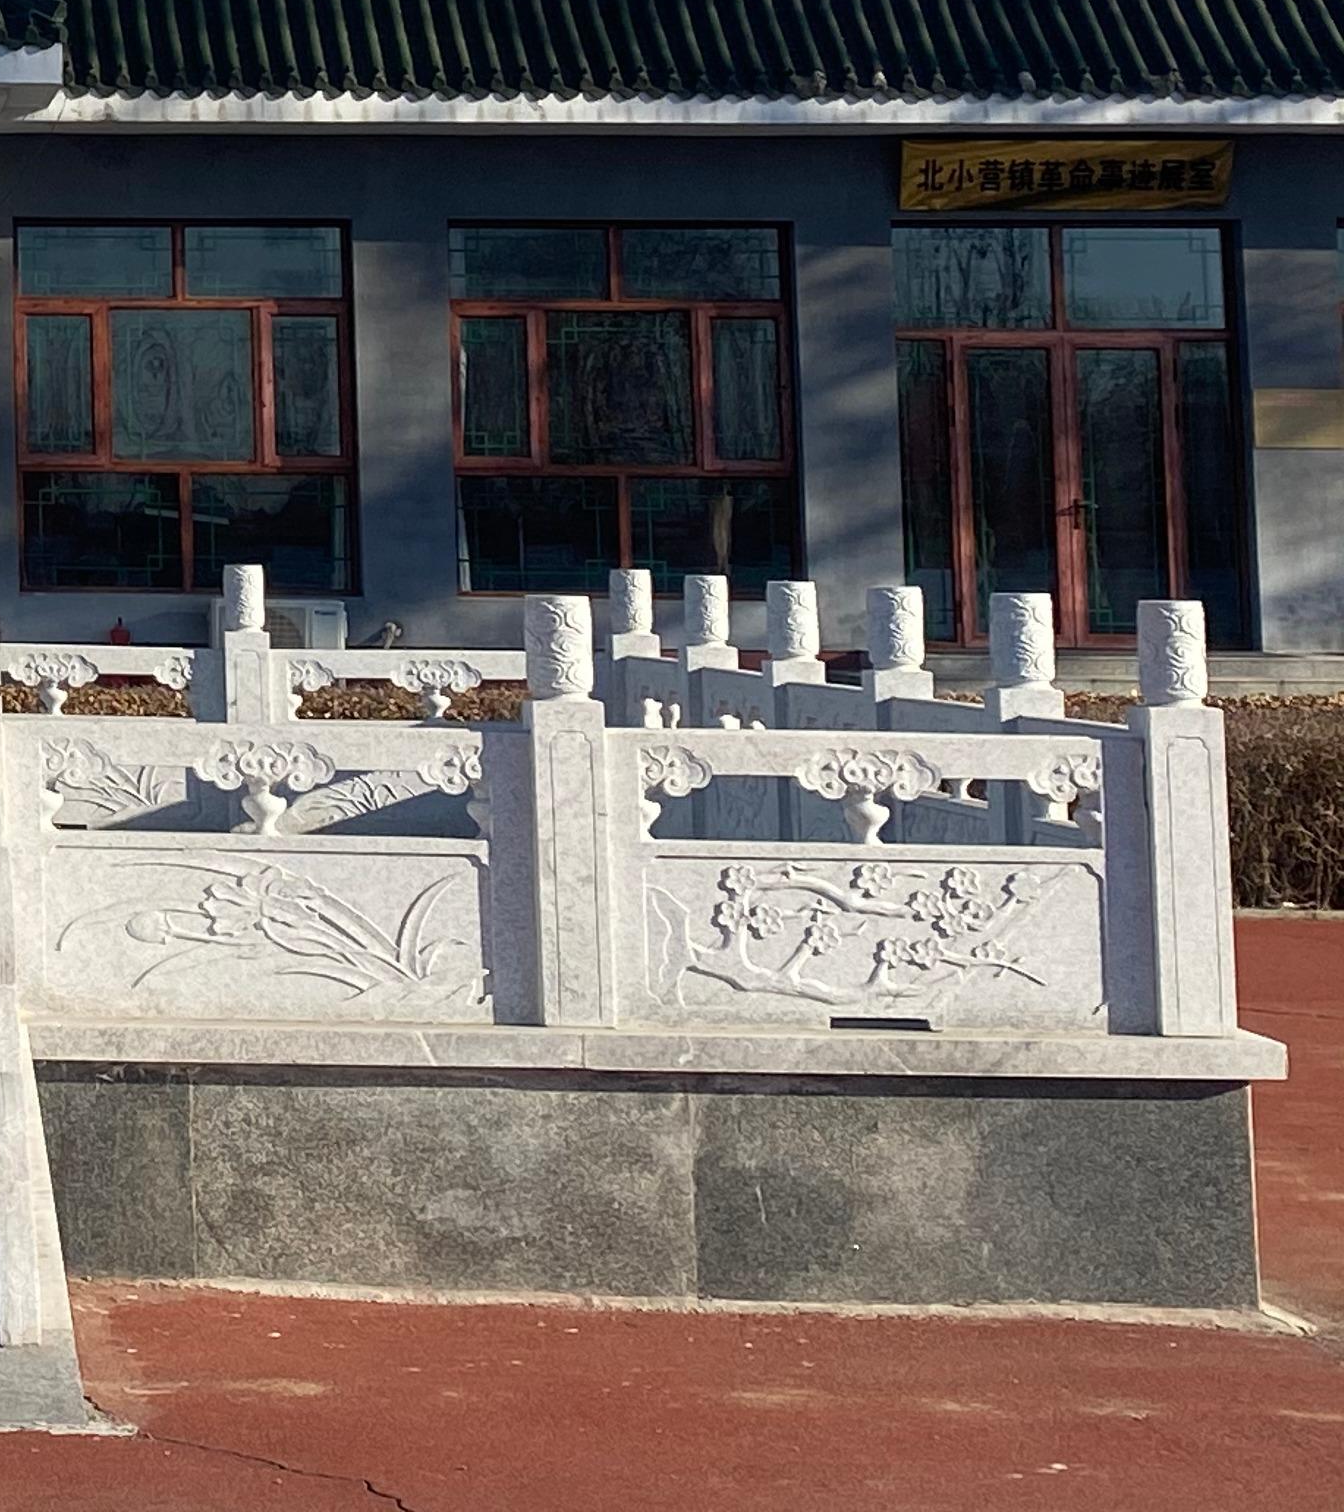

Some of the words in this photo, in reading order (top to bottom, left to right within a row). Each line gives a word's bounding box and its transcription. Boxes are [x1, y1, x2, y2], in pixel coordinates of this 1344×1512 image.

[916, 159, 1217, 193] 北小营镇革命事迹展室
